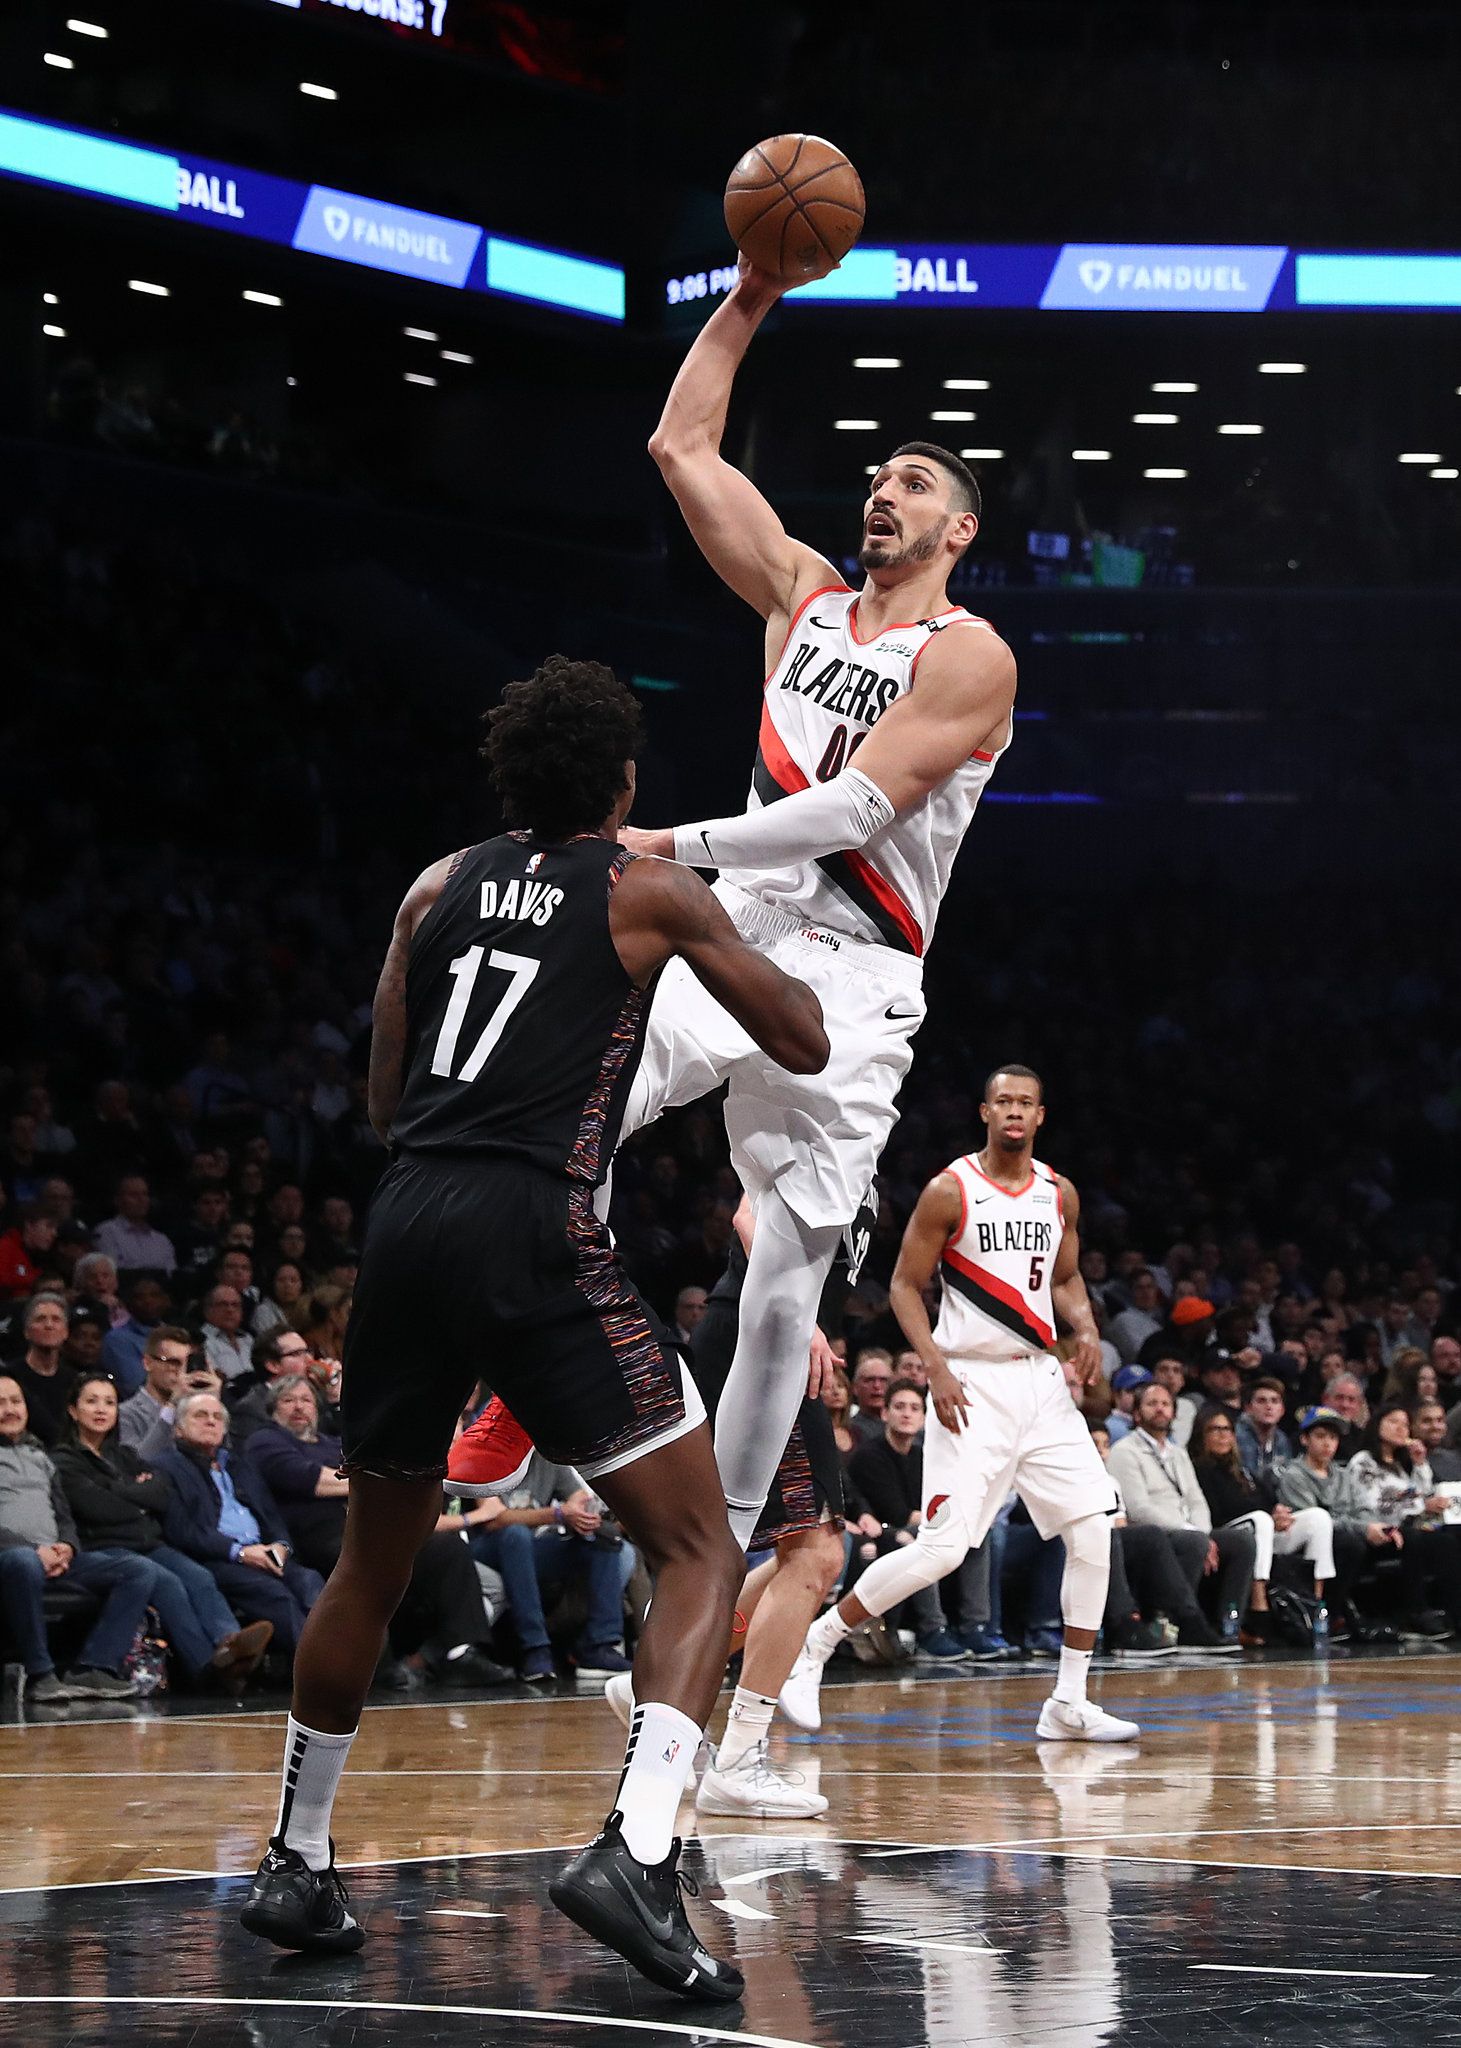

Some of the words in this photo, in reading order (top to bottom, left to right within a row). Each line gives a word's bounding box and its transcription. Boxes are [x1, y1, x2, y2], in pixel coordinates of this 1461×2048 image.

[430, 0, 448, 37] 7
[353, 217, 452, 265] FANDUEL
[1117, 264, 1248, 292] FANDUEL
[779, 643, 900, 728] BLAZERS
[801, 927, 841, 952] ripcity
[430, 944, 541, 1083] 17
[976, 1221, 1052, 1253] BLAZERS
[1028, 1256, 1045, 1292] 5
